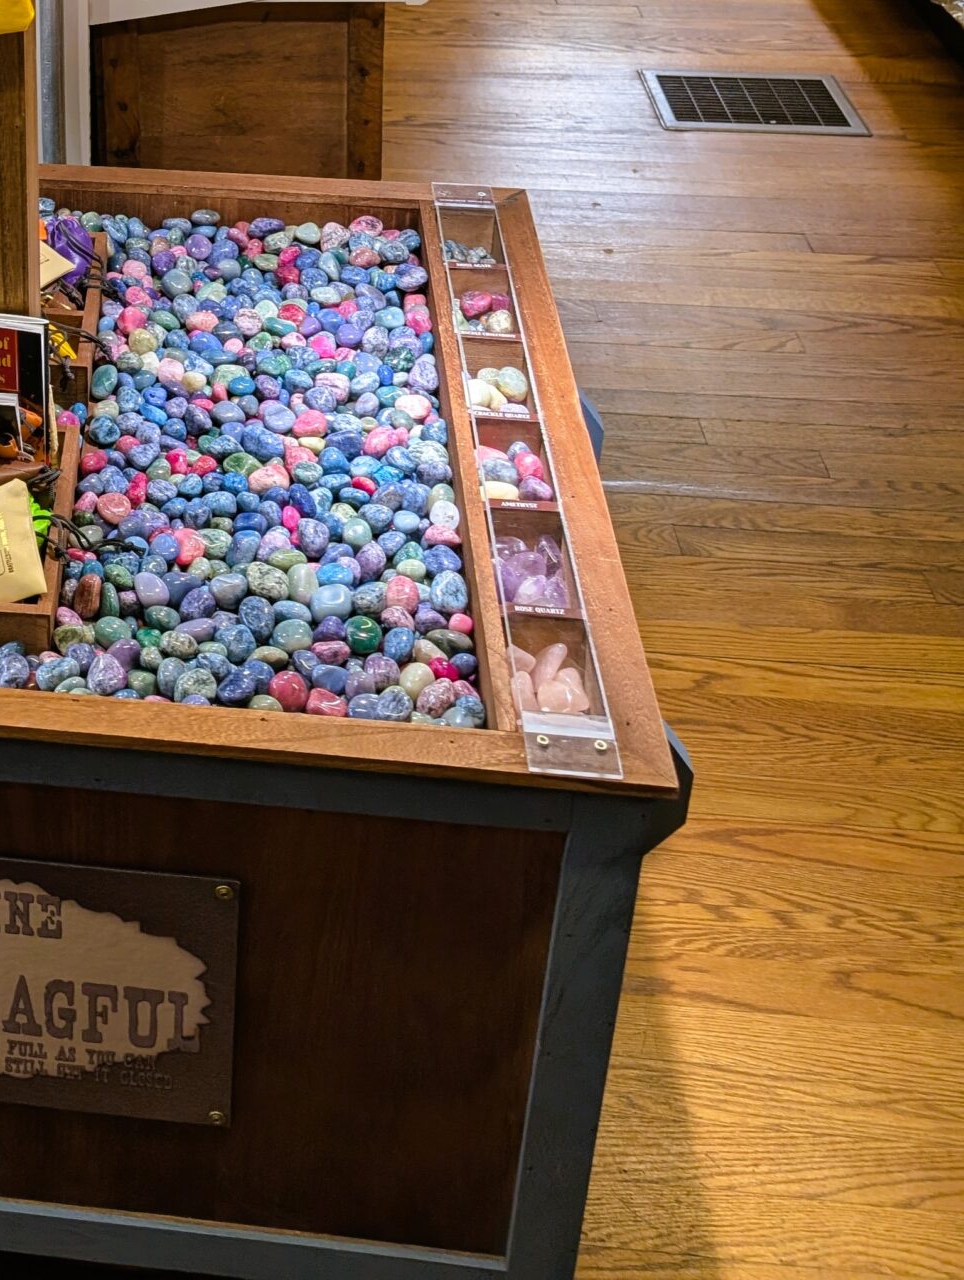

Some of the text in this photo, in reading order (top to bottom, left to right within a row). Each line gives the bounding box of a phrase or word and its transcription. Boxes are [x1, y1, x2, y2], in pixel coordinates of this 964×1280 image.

[501, 501, 538, 509] AMETHYST
[514, 605, 565, 615] ROSE QUARTZ
[6, 1039, 47, 1060] FULL
[55, 1045, 76, 1062] AS
[85, 1048, 116, 1066] YOU
[4, 1056, 47, 1075] STILL
